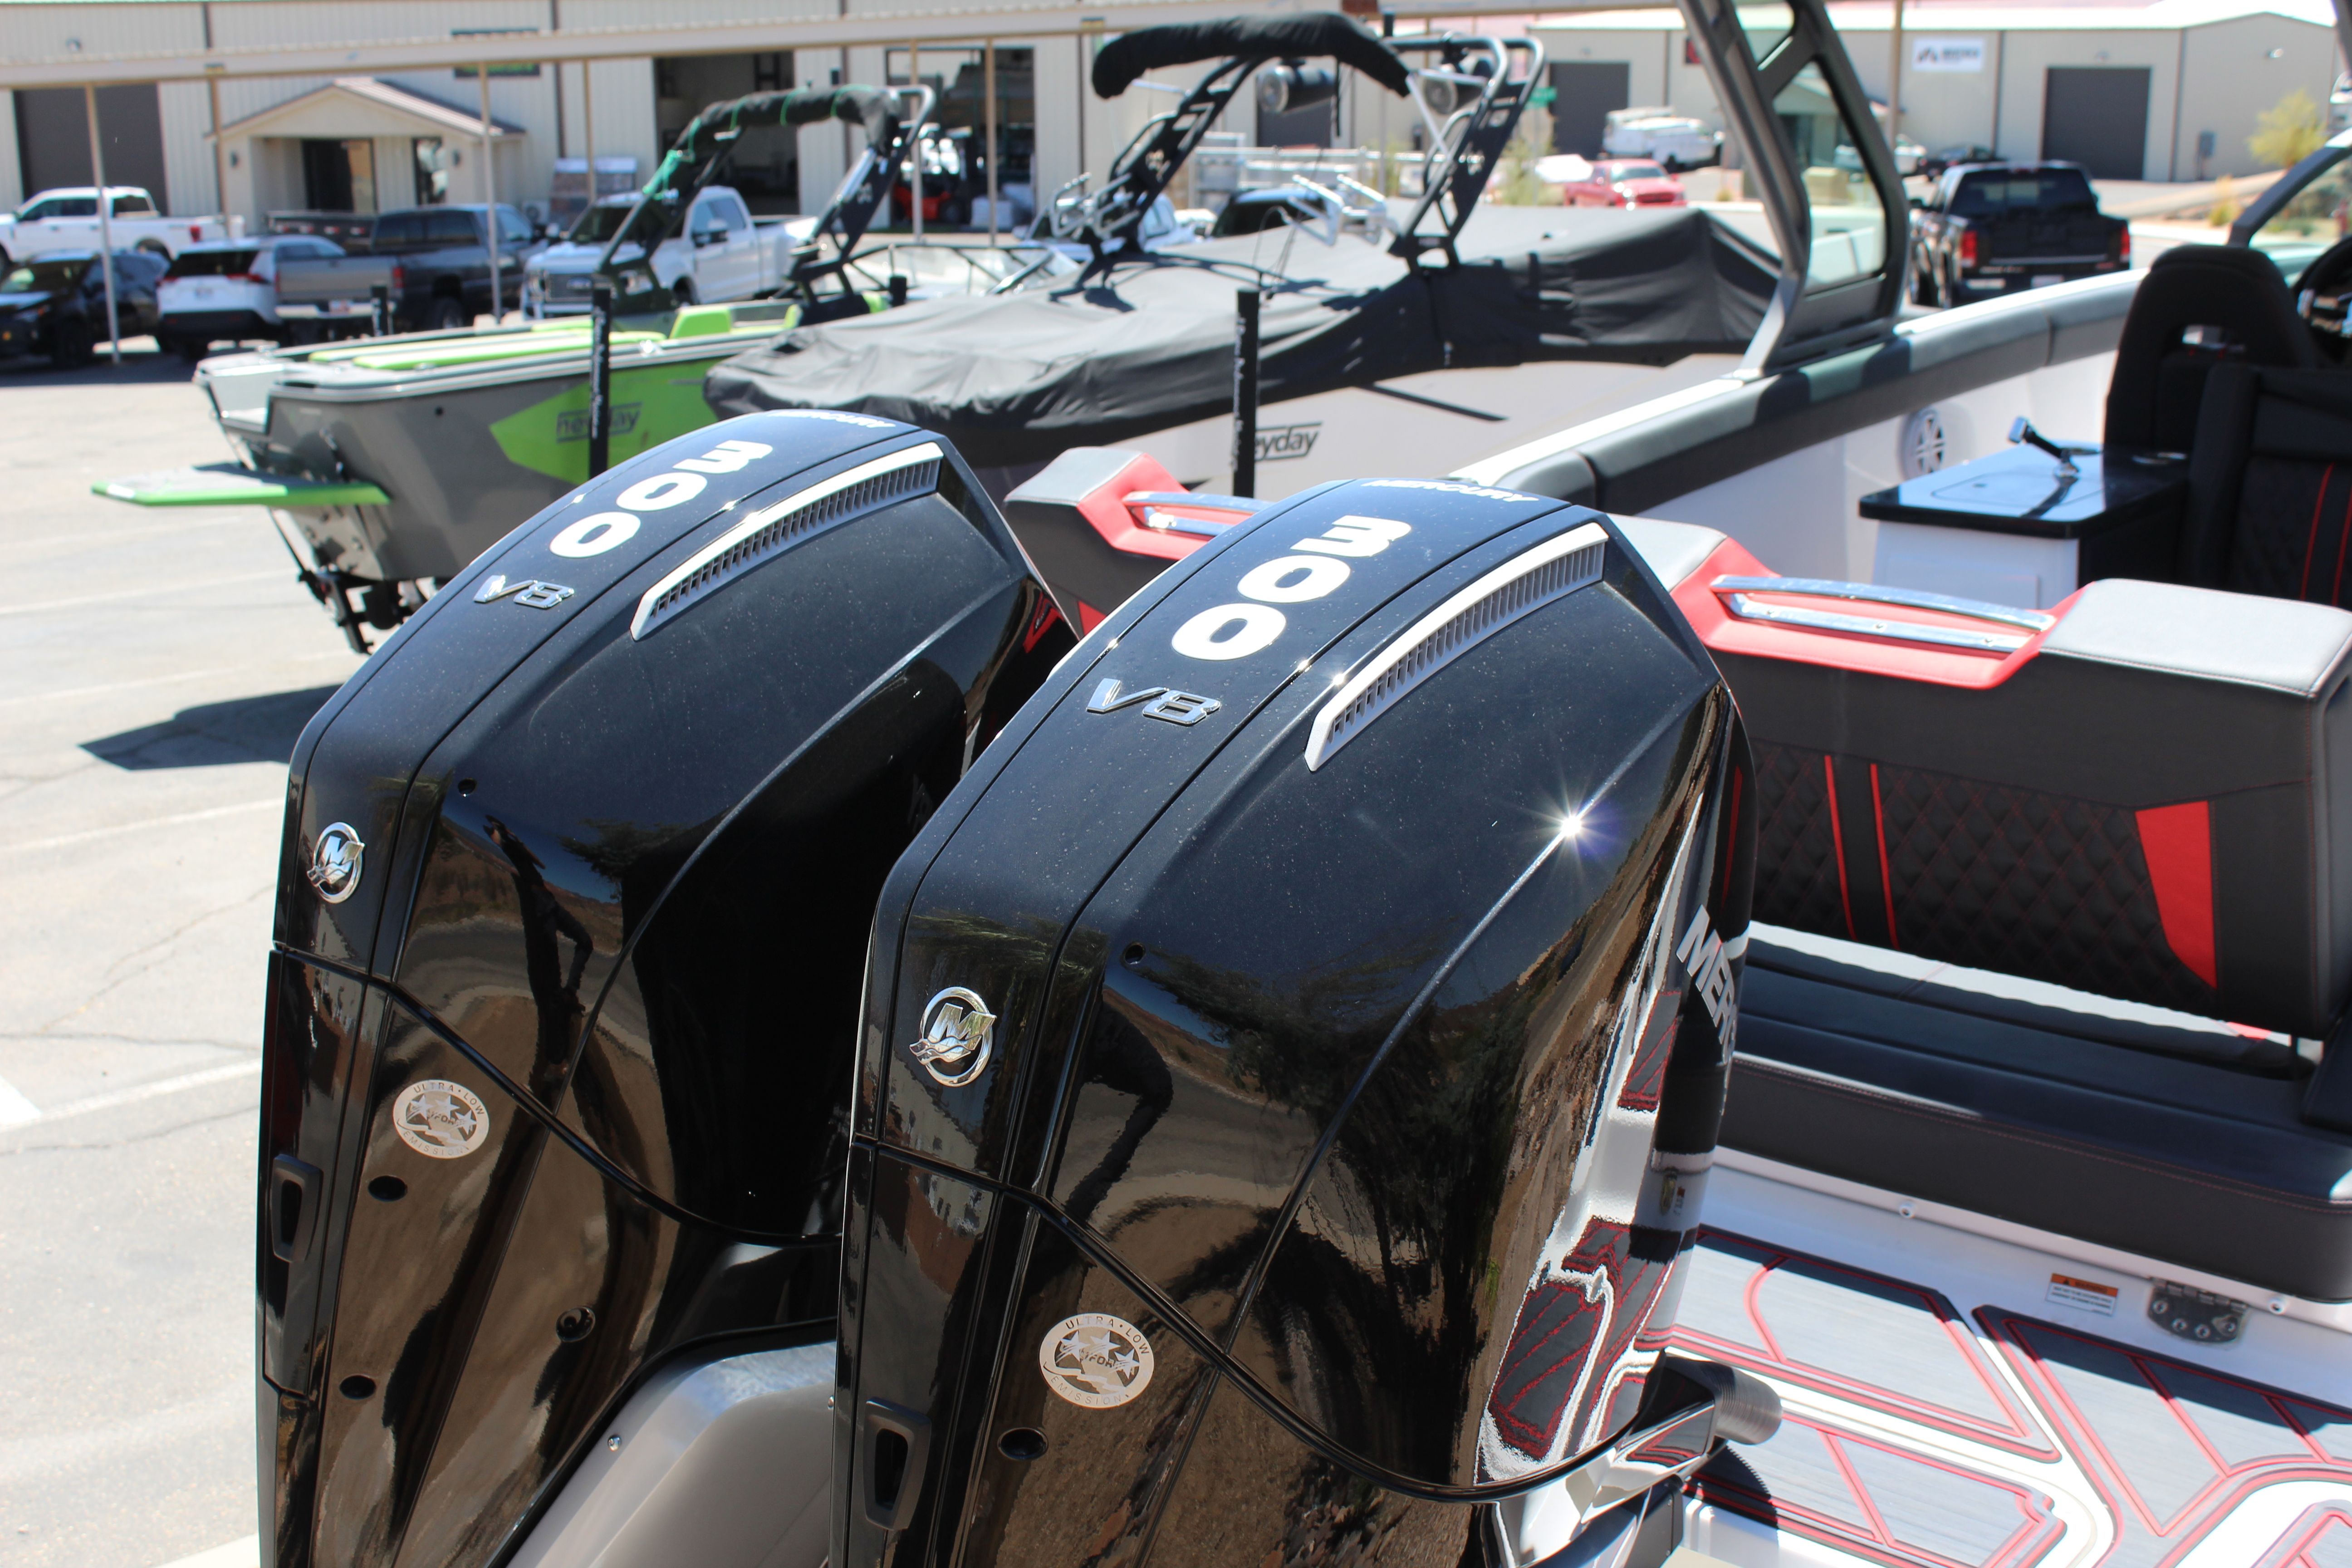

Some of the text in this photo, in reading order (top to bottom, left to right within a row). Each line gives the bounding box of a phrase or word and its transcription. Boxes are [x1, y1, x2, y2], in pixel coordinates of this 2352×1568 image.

[1254, 422, 1321, 461] yday
[1361, 479, 1539, 502] MERCURY
[473, 575, 574, 608] V8
[1171, 515, 1411, 660] 300
[1086, 678, 1221, 726] V8
[413, 1082, 485, 1115] ULTRA LOW
[1065, 1315, 1150, 1355] ULTRA LOW
[1050, 1375, 1122, 1405] EMISSION
